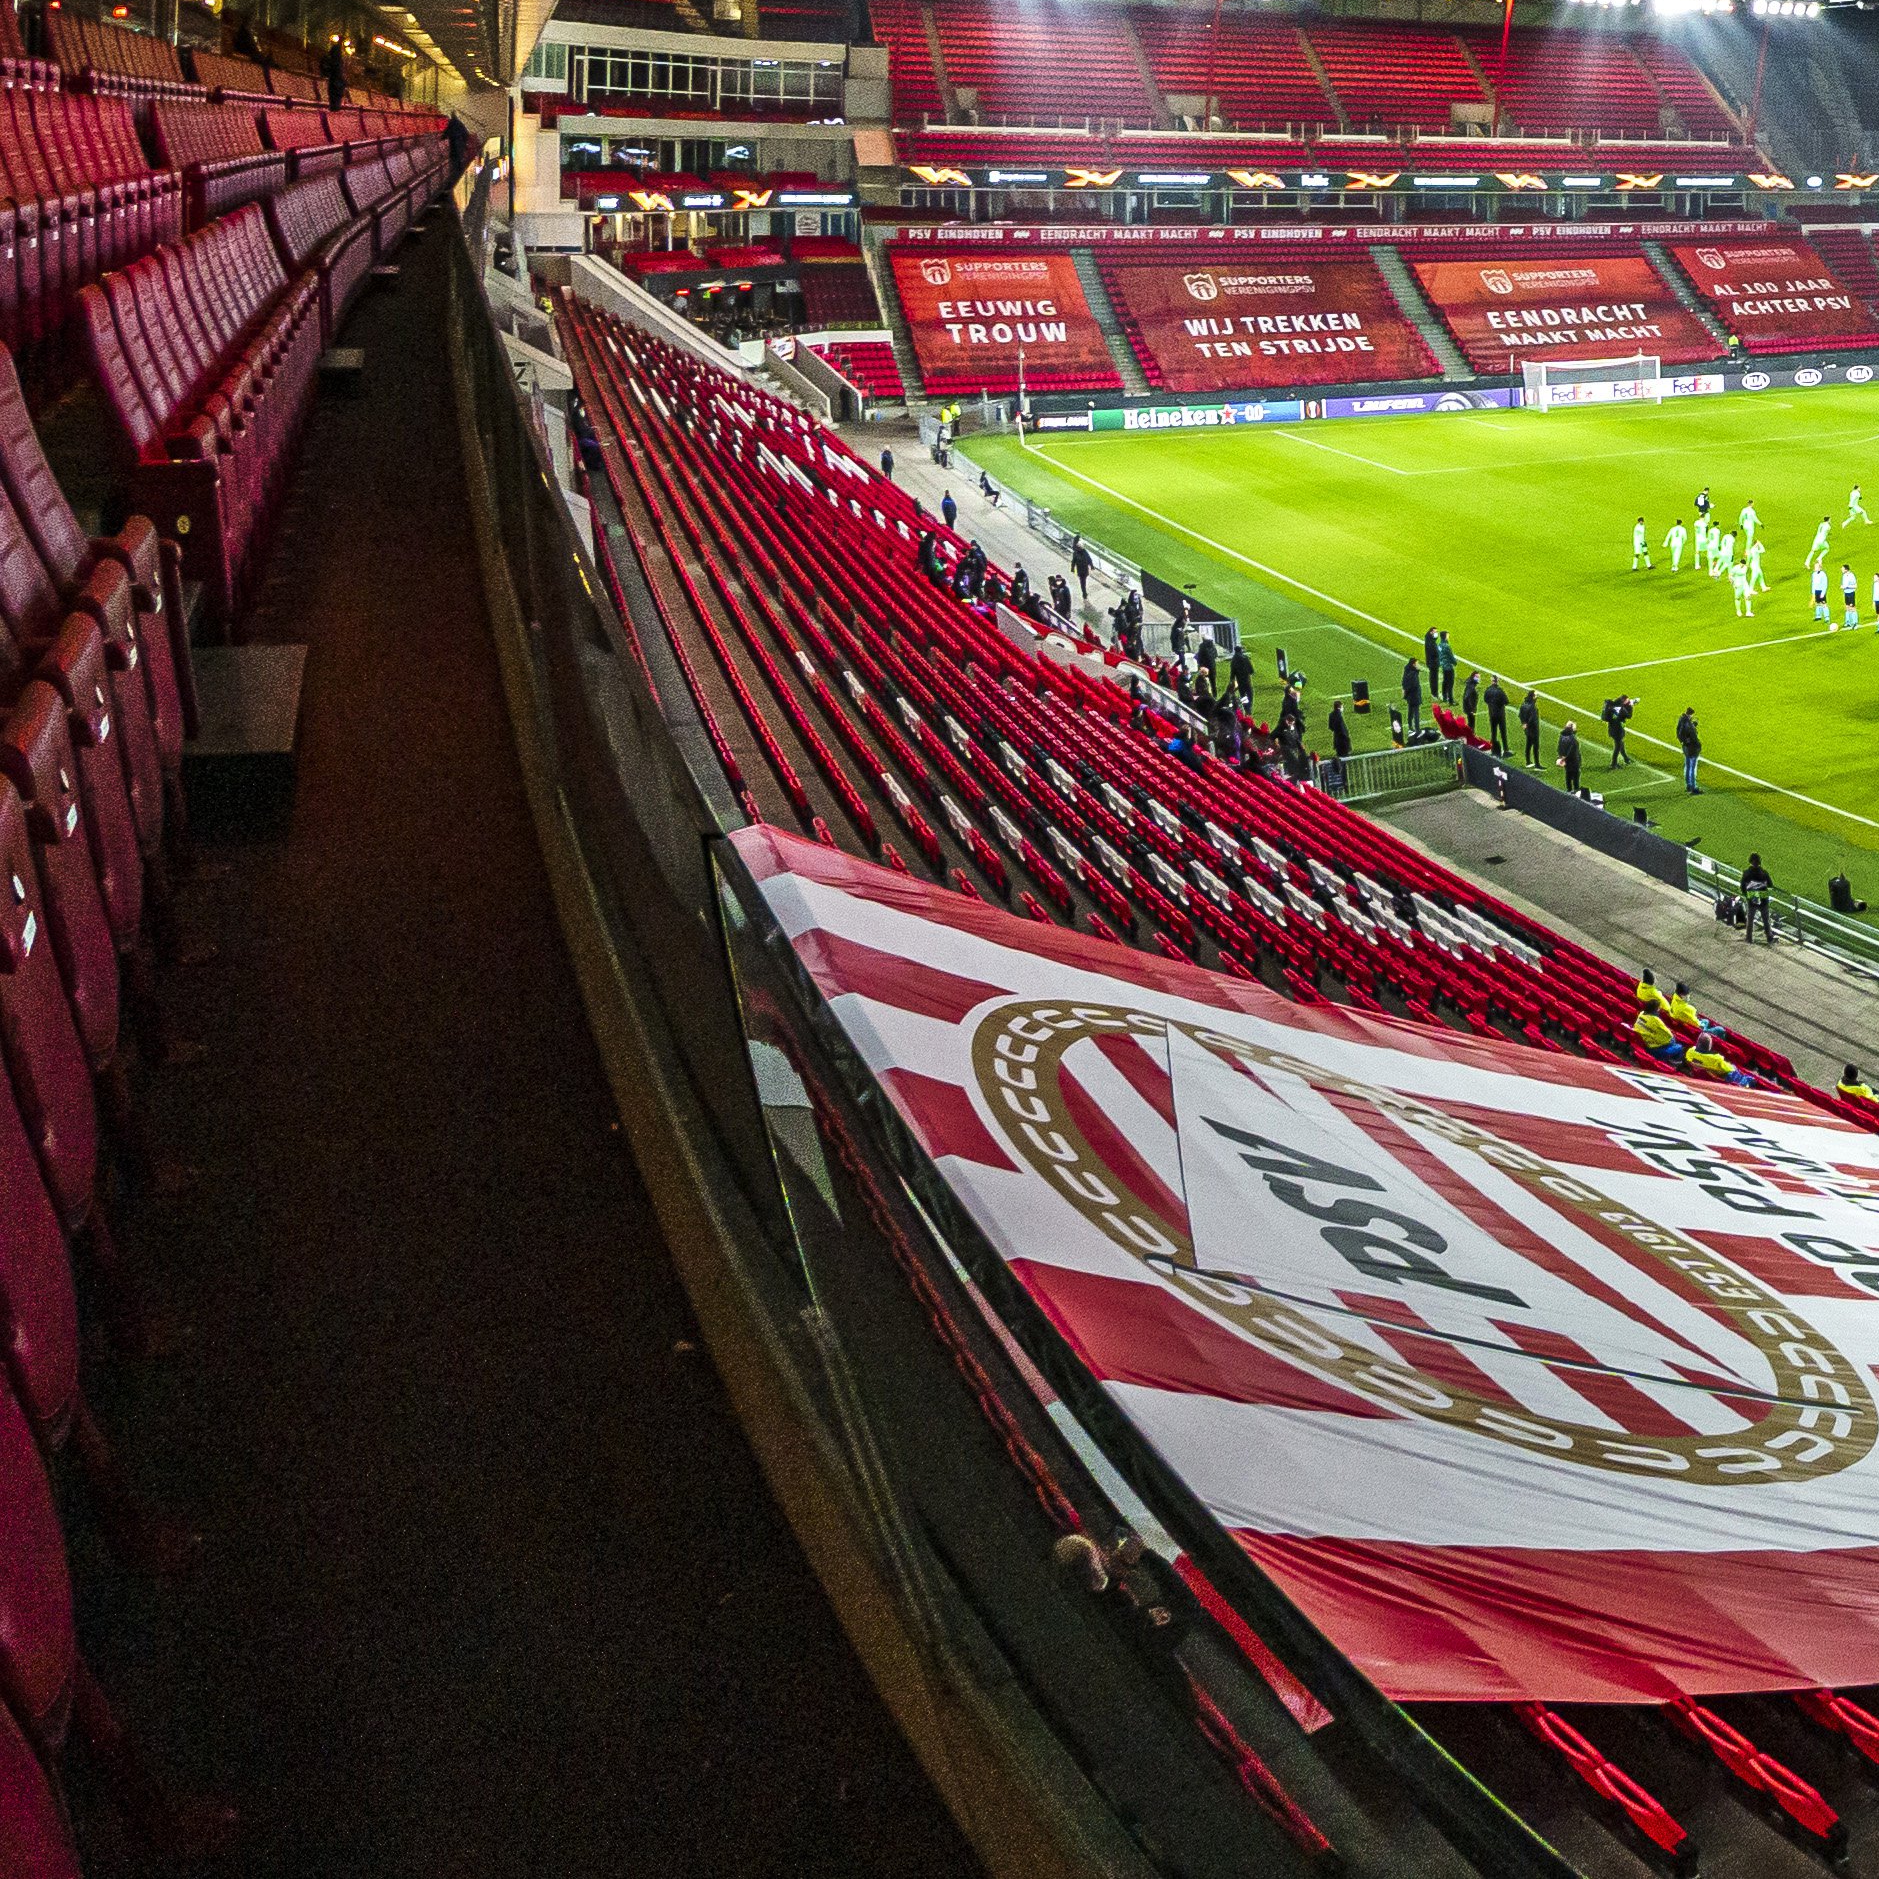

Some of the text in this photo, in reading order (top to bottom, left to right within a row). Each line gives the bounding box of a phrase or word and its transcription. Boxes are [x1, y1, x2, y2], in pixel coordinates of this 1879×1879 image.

[908, 228, 931, 239] PSV
[1040, 229, 1107, 240] EENDRACHT
[1113, 229, 1154, 240] MAAKT
[1160, 229, 1198, 239] MACHT
[1234, 229, 1255, 239] PSV
[1356, 228, 1418, 238] EENDRACHT
[1423, 227, 1460, 237] MAAKT
[1465, 227, 1500, 237] MACHT
[1532, 226, 1552, 236] PSV
[1641, 224, 1695, 234] EENDRACHT
[954, 261, 1048, 272] SUPPORTERS
[1511, 269, 1597, 281] SUPPORTERS
[1218, 275, 1313, 287] SUPPORTERS
[1713, 278, 1835, 297] AL 100 JAAR
[938, 300, 1057, 319] EEUWIG
[1486, 303, 1648, 329] EENDRACHT
[1732, 295, 1852, 317] ACHTER PSV
[946, 322, 1067, 344] TROUW
[1183, 312, 1362, 337] WIJ TREKKEN
[1498, 325, 1663, 347] MAAKT MACHT
[1195, 336, 1374, 359] TEN STRIJDE
[1551, 386, 1593, 402] FedEx
[1672, 378, 1712, 394] FedEx
[1123, 407, 1221, 429] Heineken
[1199, 1115, 1532, 1309] PSV
[1668, 1256, 1763, 1300] EST
